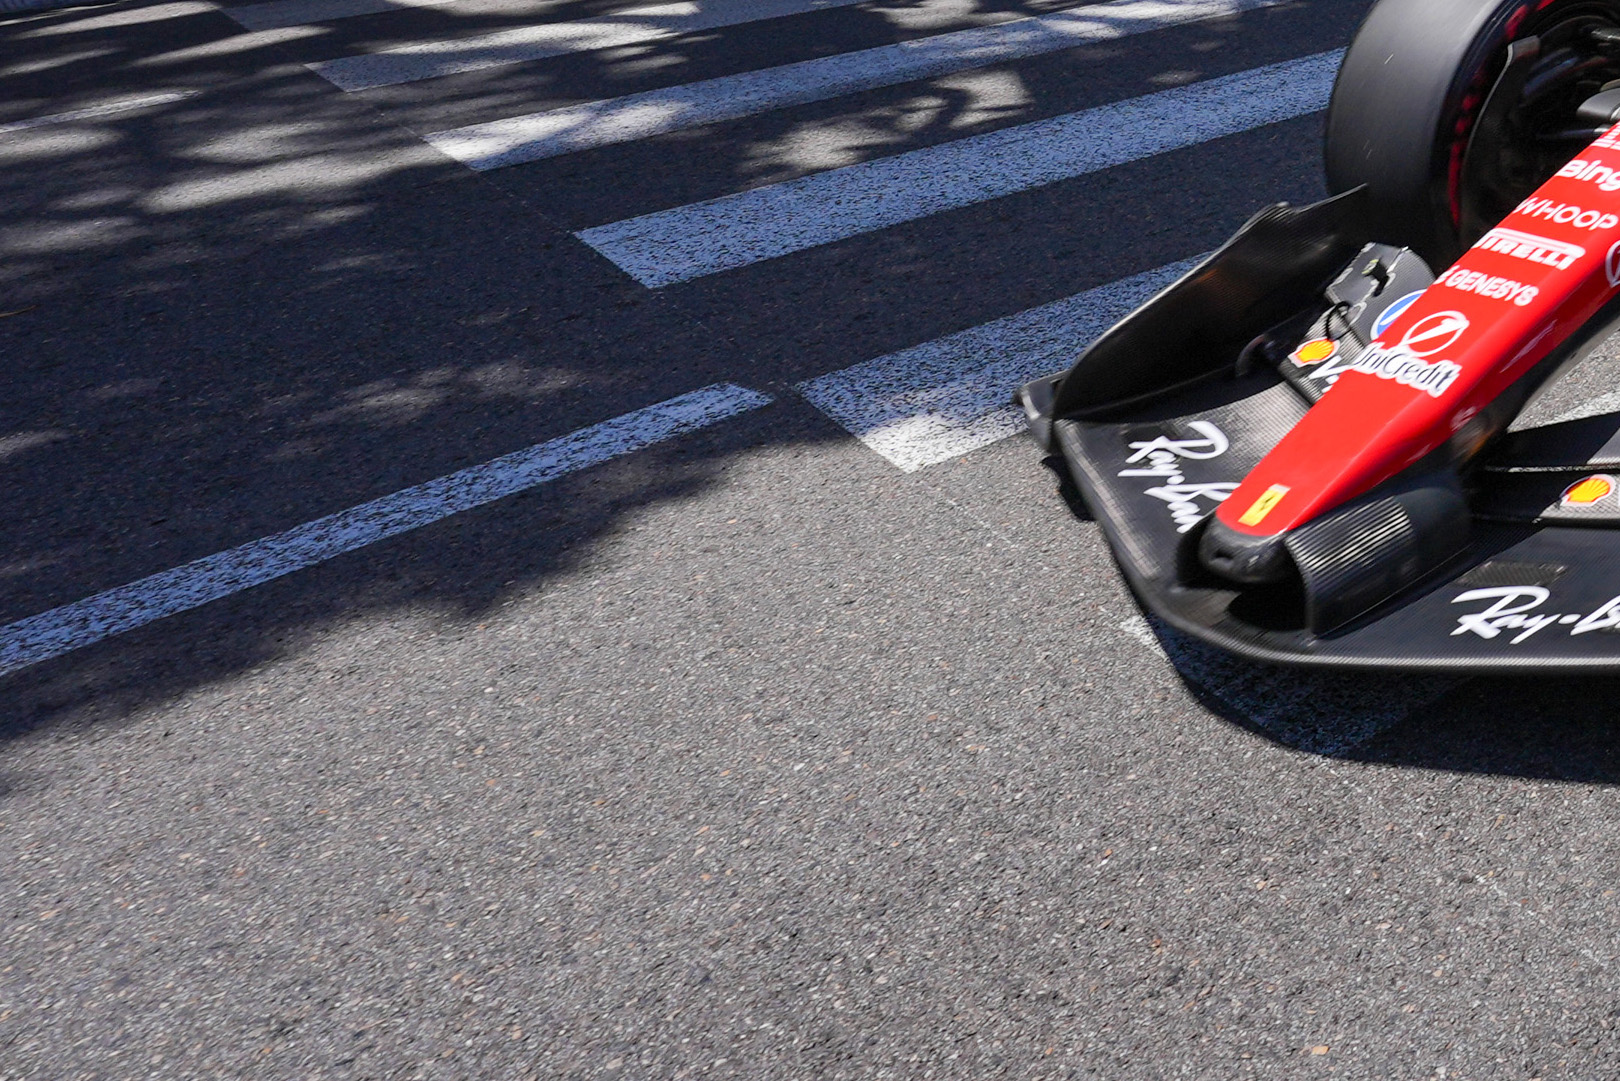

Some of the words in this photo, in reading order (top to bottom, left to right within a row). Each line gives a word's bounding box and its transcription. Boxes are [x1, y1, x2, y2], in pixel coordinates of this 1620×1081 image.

[1512, 196, 1619, 231] WHOOP
[1471, 227, 1586, 271] PIRELLI
[1444, 268, 1539, 307] GENESYS
